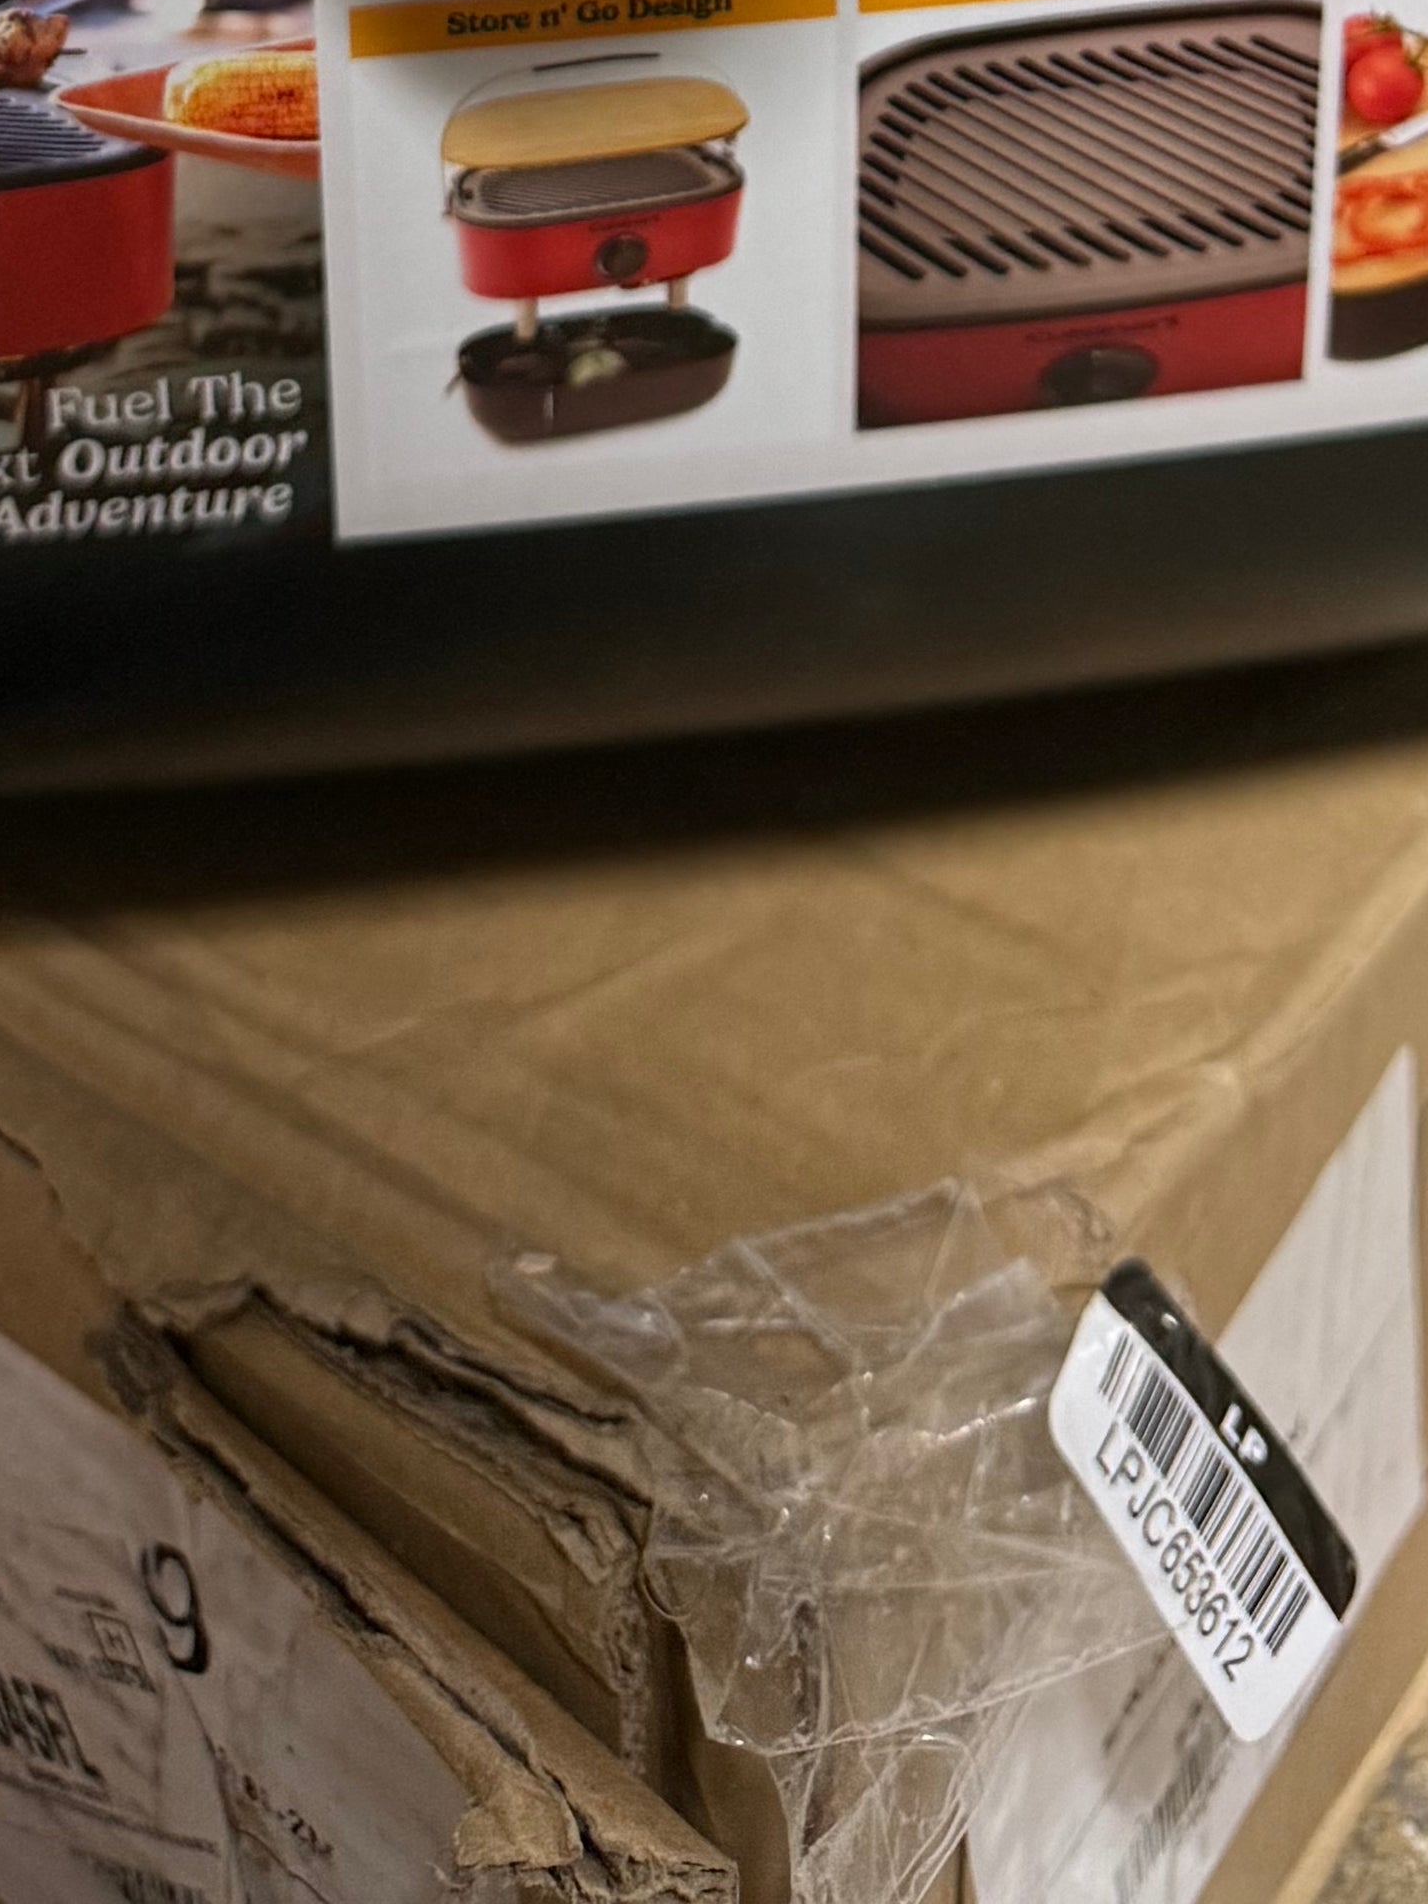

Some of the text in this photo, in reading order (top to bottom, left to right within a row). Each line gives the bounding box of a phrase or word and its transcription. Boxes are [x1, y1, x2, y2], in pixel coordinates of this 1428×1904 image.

[445, 9, 530, 36] Store
[575, 0, 620, 24] Go
[46, 370, 303, 431] Fuel The
[57, 425, 309, 482] Outdoor
[1220, 1401, 1270, 1466] LP
[1095, 1418, 1258, 1684] LPJC653612
